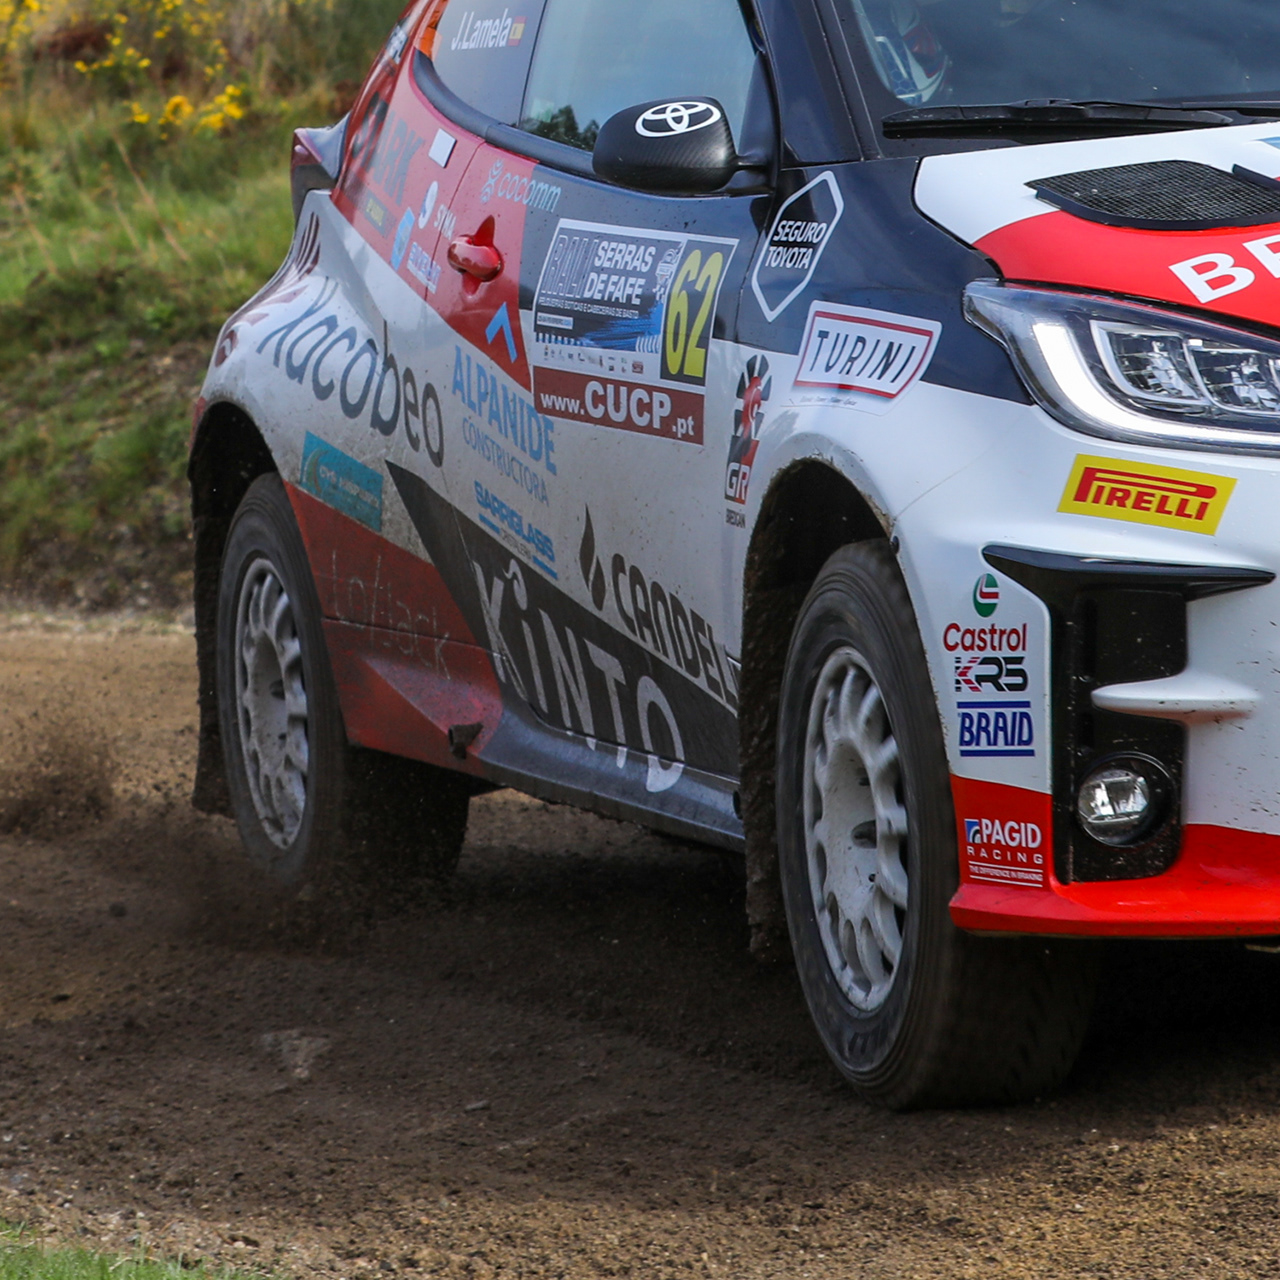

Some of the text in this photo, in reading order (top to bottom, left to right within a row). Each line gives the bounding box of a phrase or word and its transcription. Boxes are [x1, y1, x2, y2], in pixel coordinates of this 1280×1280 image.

[451, 8, 512, 51] J.Lamela
[497, 170, 562, 213] cocomm
[773, 220, 827, 243] SEGURO
[593, 240, 656, 273] SERRAS
[765, 246, 814, 269] TOYOTA
[583, 272, 646, 305] DE FAFE
[666, 249, 724, 378] 62
[810, 330, 917, 384] TURINI
[452, 344, 558, 476] ALPANIDE
[540, 380, 695, 437] www.CUCP.pt
[462, 417, 550, 508] CONSTRUCTORA
[726, 462, 750, 501] GR
[1073, 466, 1218, 521] PIRELLI
[612, 553, 740, 705] CANDEL
[943, 622, 1027, 652] Castrol
[959, 711, 1034, 747] BRAID
[981, 818, 1042, 848] PAGID
[967, 846, 1043, 864] RACING
